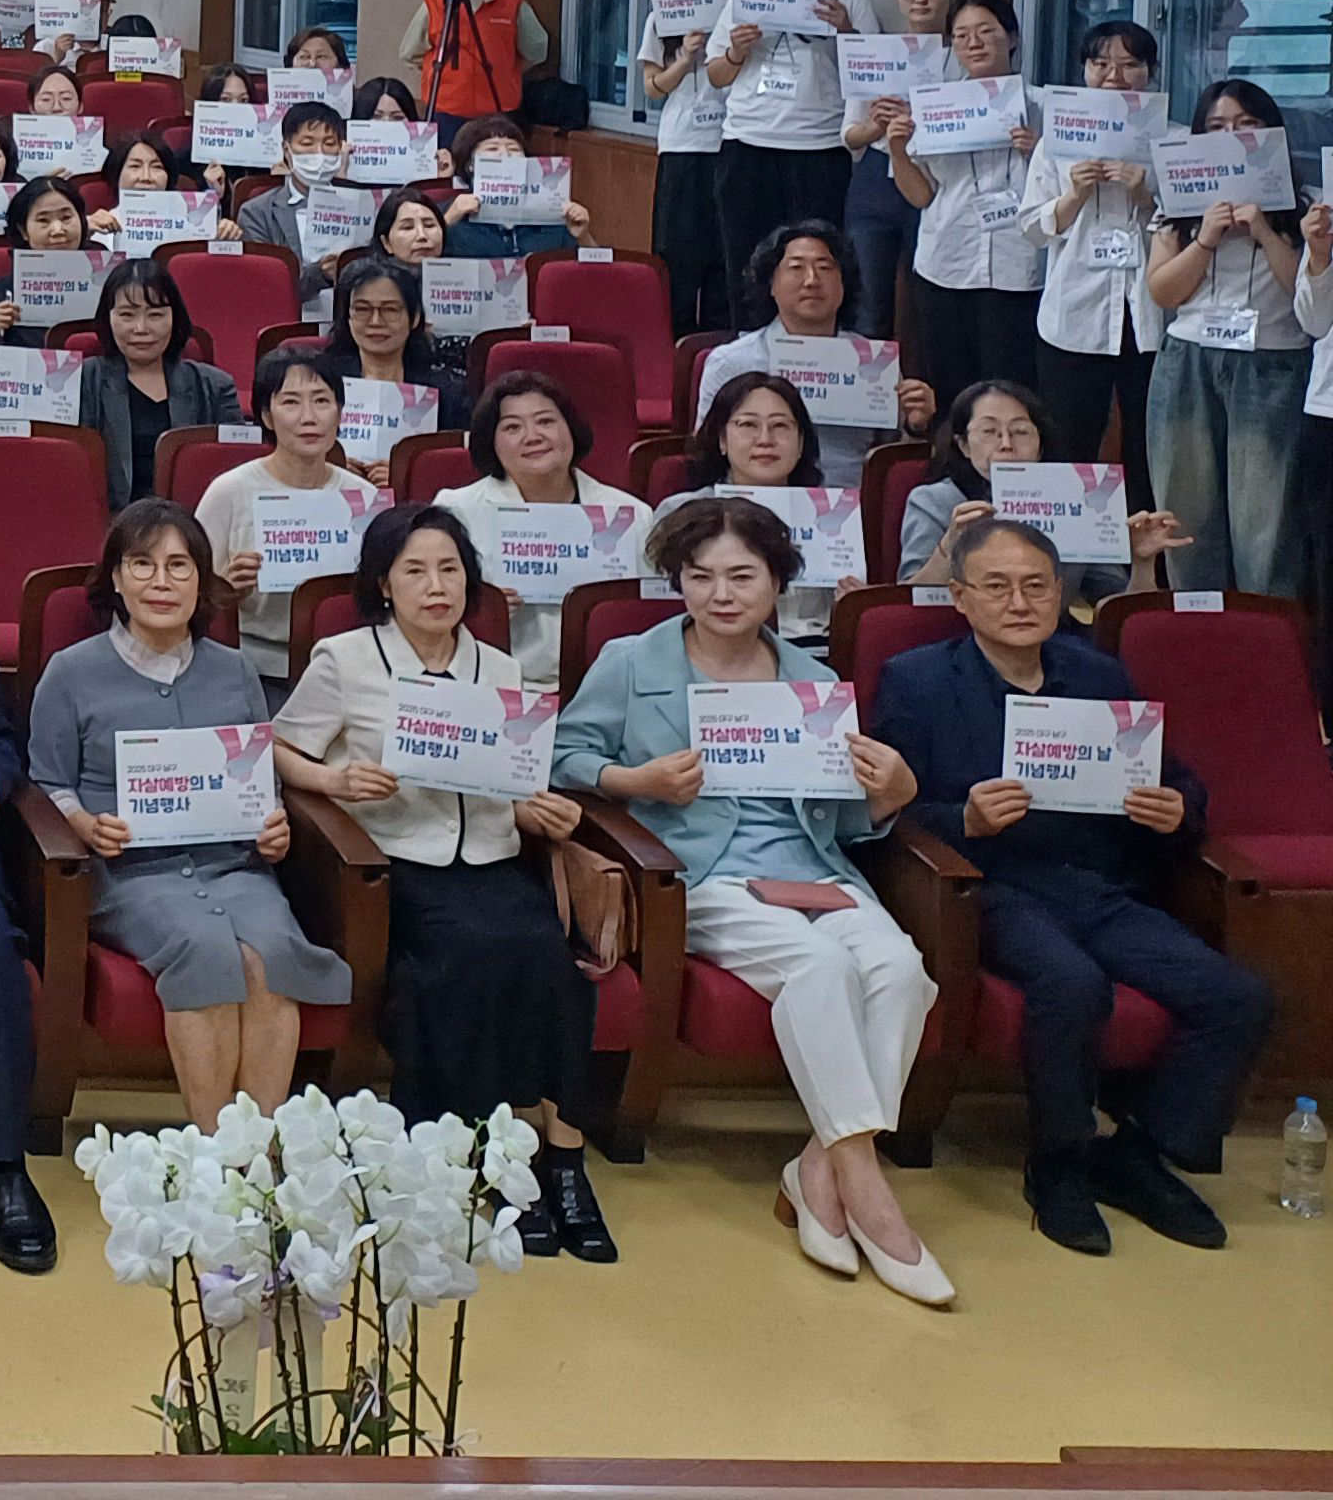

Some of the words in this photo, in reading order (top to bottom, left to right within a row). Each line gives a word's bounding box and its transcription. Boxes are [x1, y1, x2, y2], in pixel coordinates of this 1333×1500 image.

[983, 206, 1018, 223] STAFF
[396, 715, 476, 742] 자살예방의
[481, 729, 498, 746] 날
[698, 727, 778, 743] 자살예방의
[783, 727, 799, 742] 날
[395, 735, 458, 760] 기념행사
[700, 747, 764, 763] 기념행사
[1015, 740, 1091, 760] 자살예방의
[1096, 745, 1112, 761] 날
[1015, 761, 1075, 779] 기념행사
[127, 775, 203, 793] 자살예방의
[208, 773, 223, 789] 날
[129, 796, 189, 813] 기념행사
